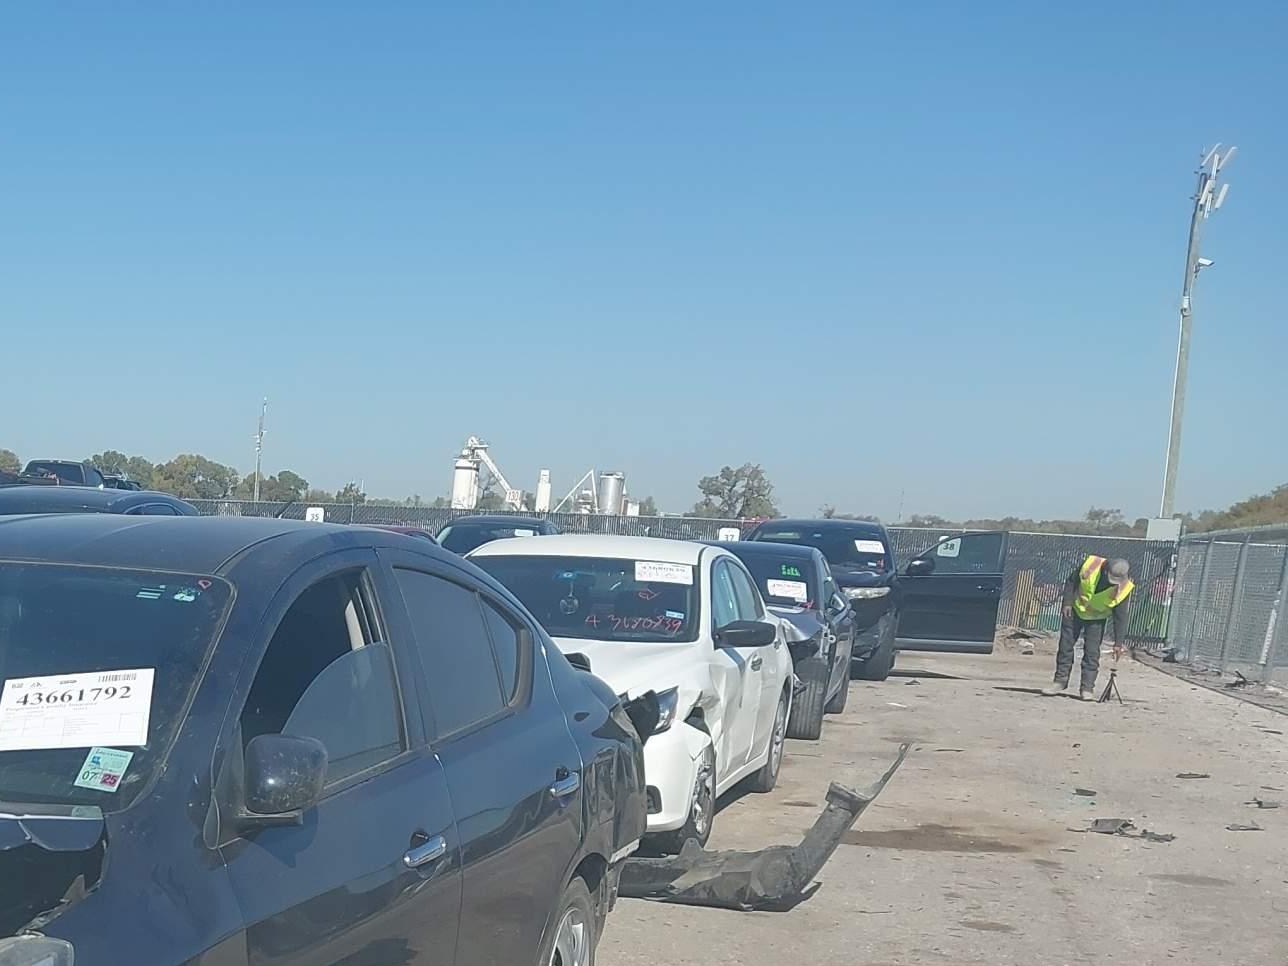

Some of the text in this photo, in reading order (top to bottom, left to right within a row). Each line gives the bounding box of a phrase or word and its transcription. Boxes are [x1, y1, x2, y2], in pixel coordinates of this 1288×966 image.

[16, 685, 132, 706] 43661792
[81, 769, 118, 786] 07 25
